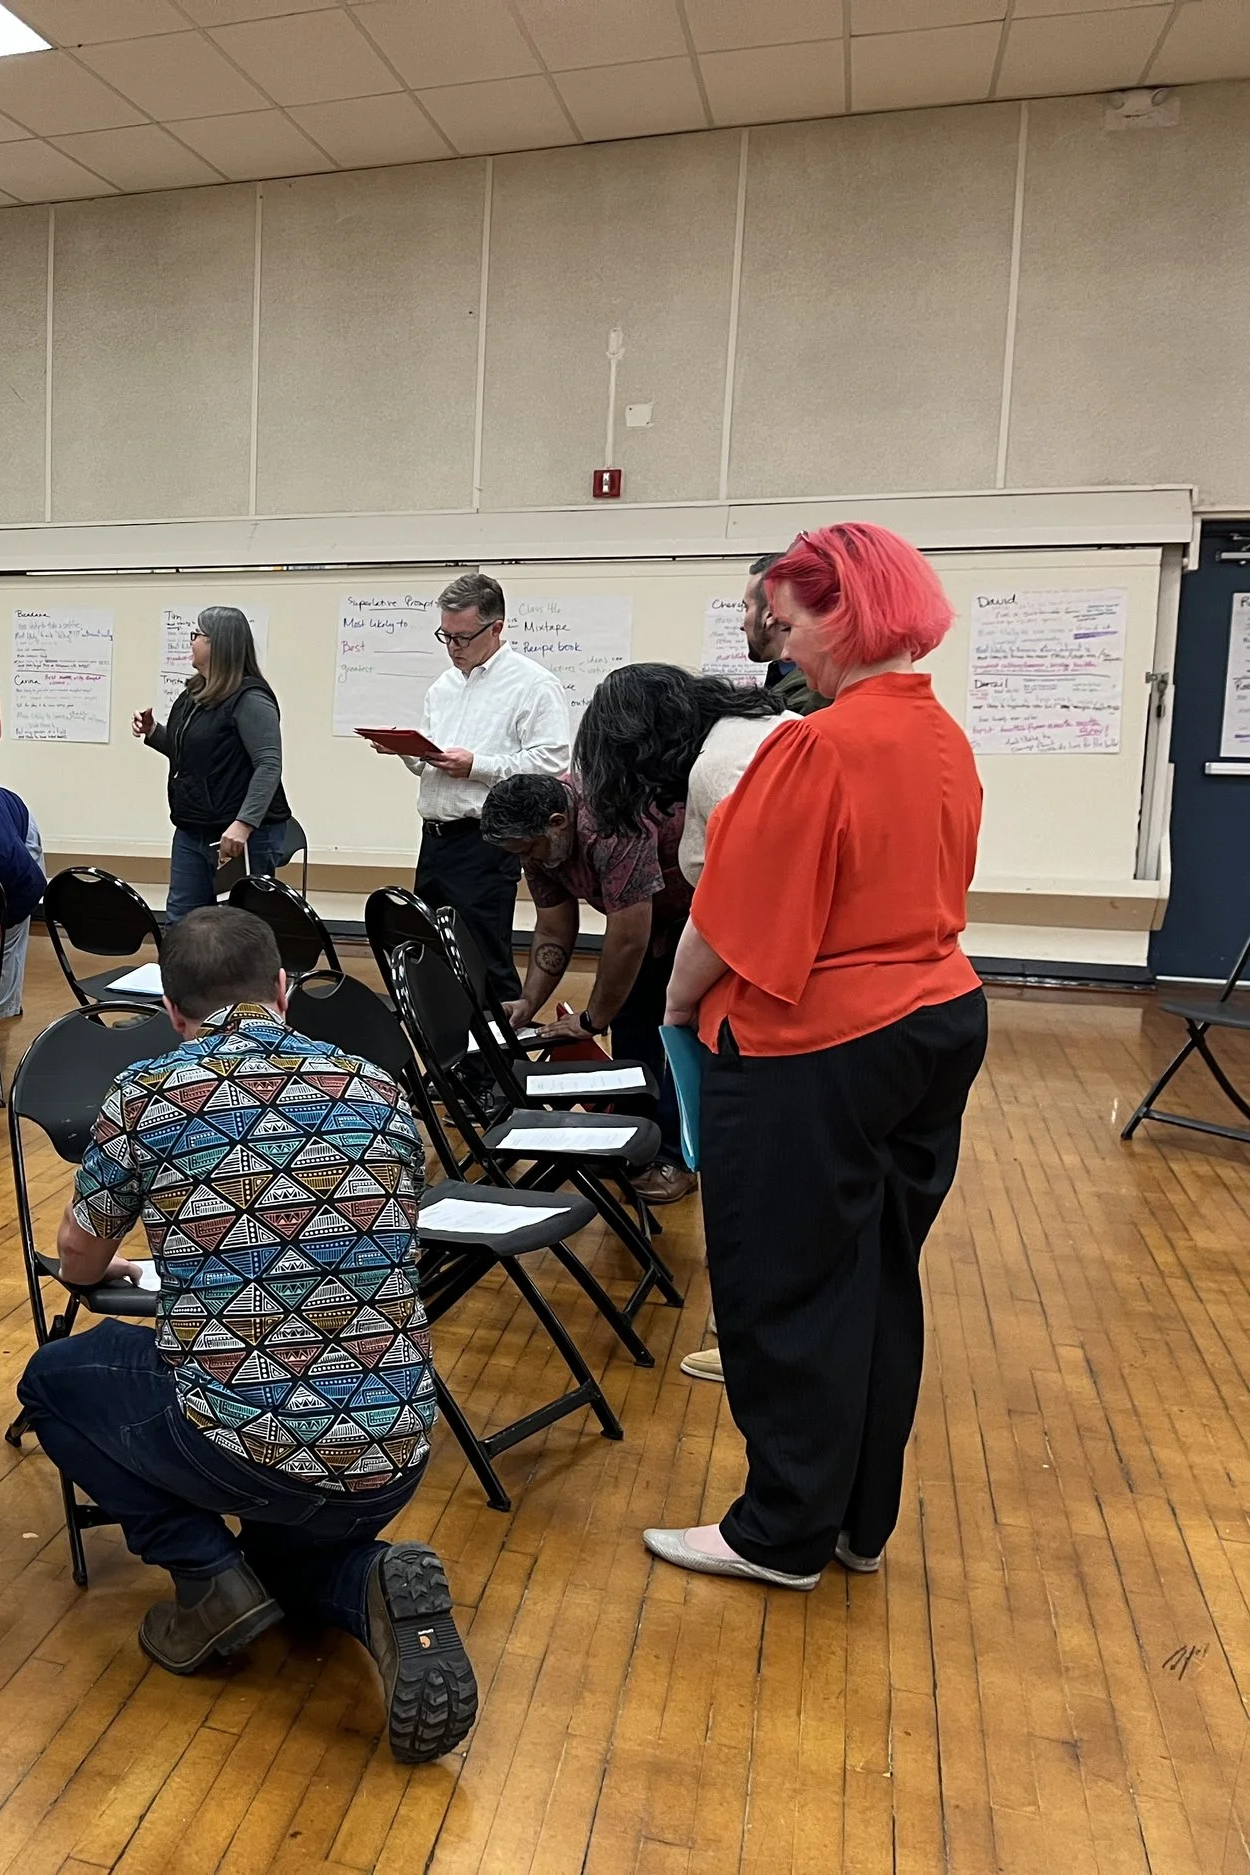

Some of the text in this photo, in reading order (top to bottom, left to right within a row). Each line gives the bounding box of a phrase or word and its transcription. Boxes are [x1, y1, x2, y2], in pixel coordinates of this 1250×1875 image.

[348, 597, 396, 612] Superlative
[712, 599, 745, 612] Chery
[977, 594, 1017, 608] David
[519, 603, 543, 615] Class
[343, 618, 365, 628] Most
[524, 621, 571, 637] Mixtape
[342, 640, 365, 655] Best
[523, 641, 555, 658] Recipe
[558, 641, 583, 652] book
